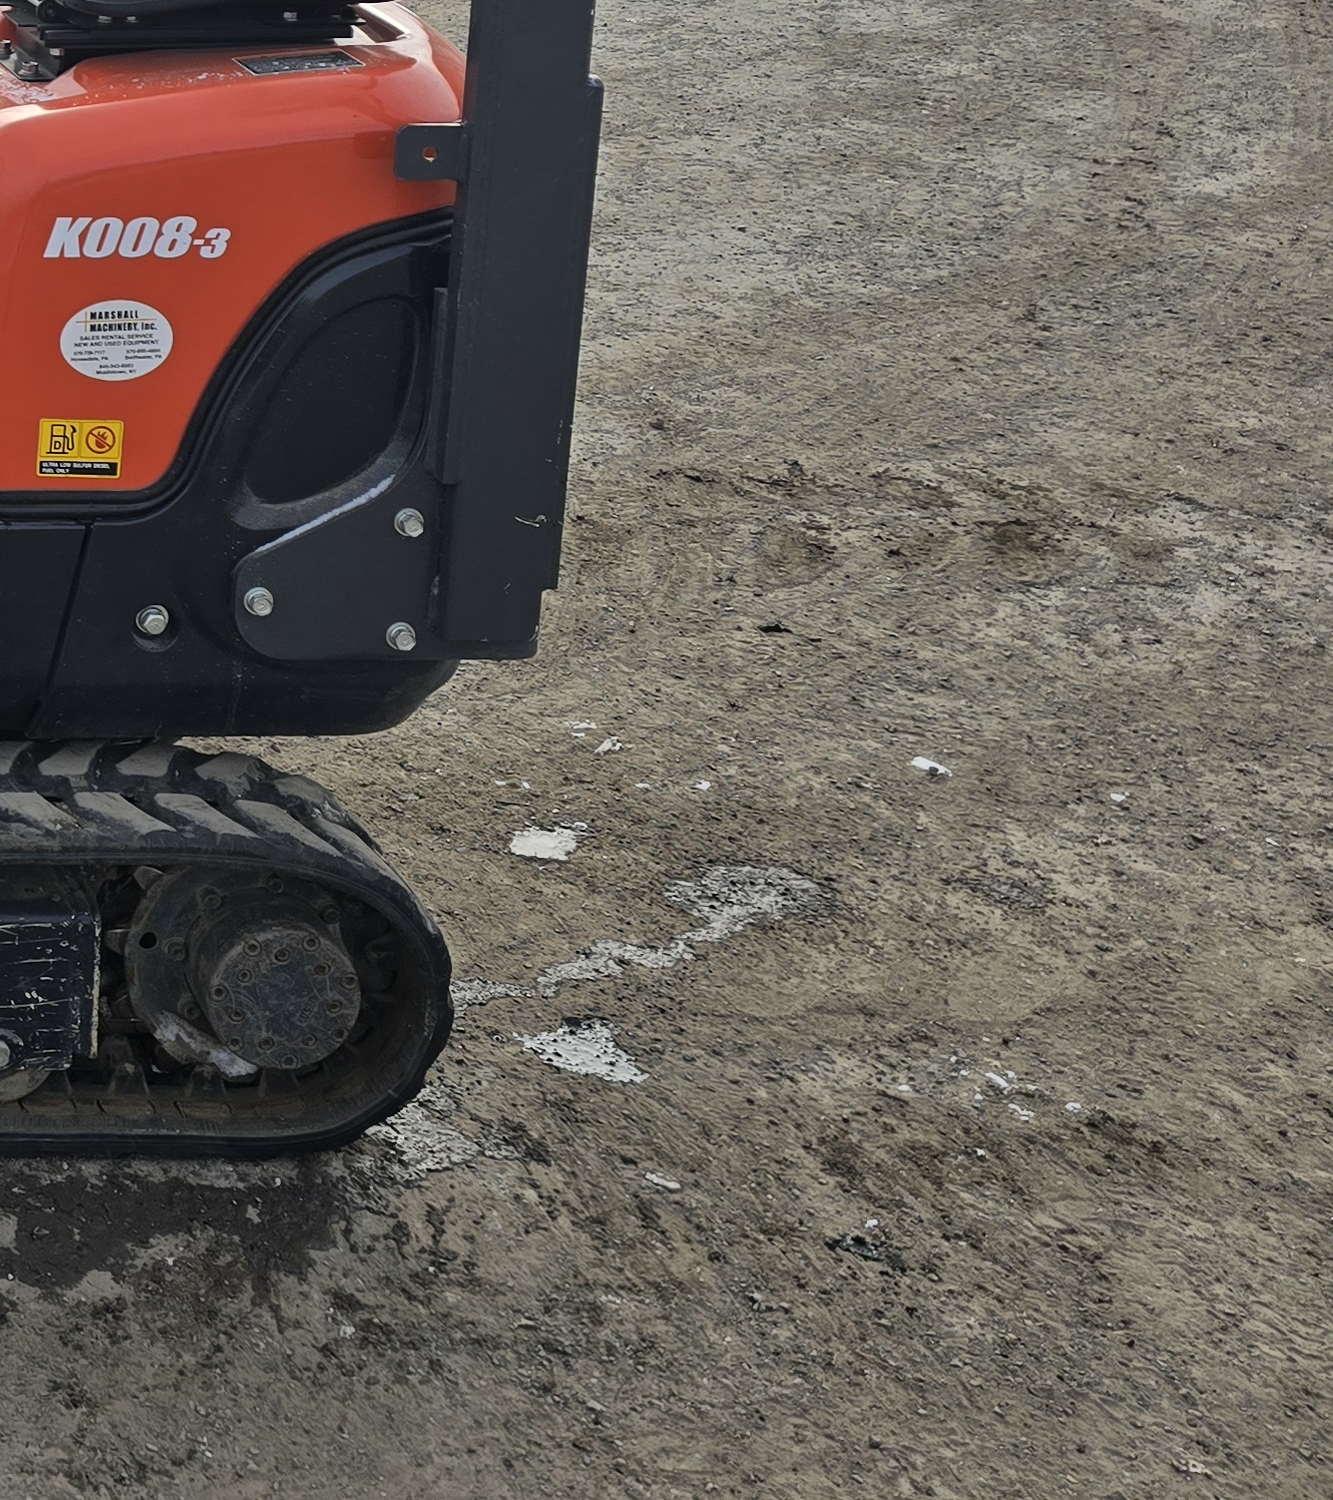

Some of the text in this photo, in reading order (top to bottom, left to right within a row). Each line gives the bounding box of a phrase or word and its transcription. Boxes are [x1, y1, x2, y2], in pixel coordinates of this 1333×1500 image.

[43, 216, 231, 258] K008-3
[90, 310, 138, 320] MARSHALL
[90, 322, 157, 332] MACHINERY, Inc.
[54, 440, 62, 450] D
